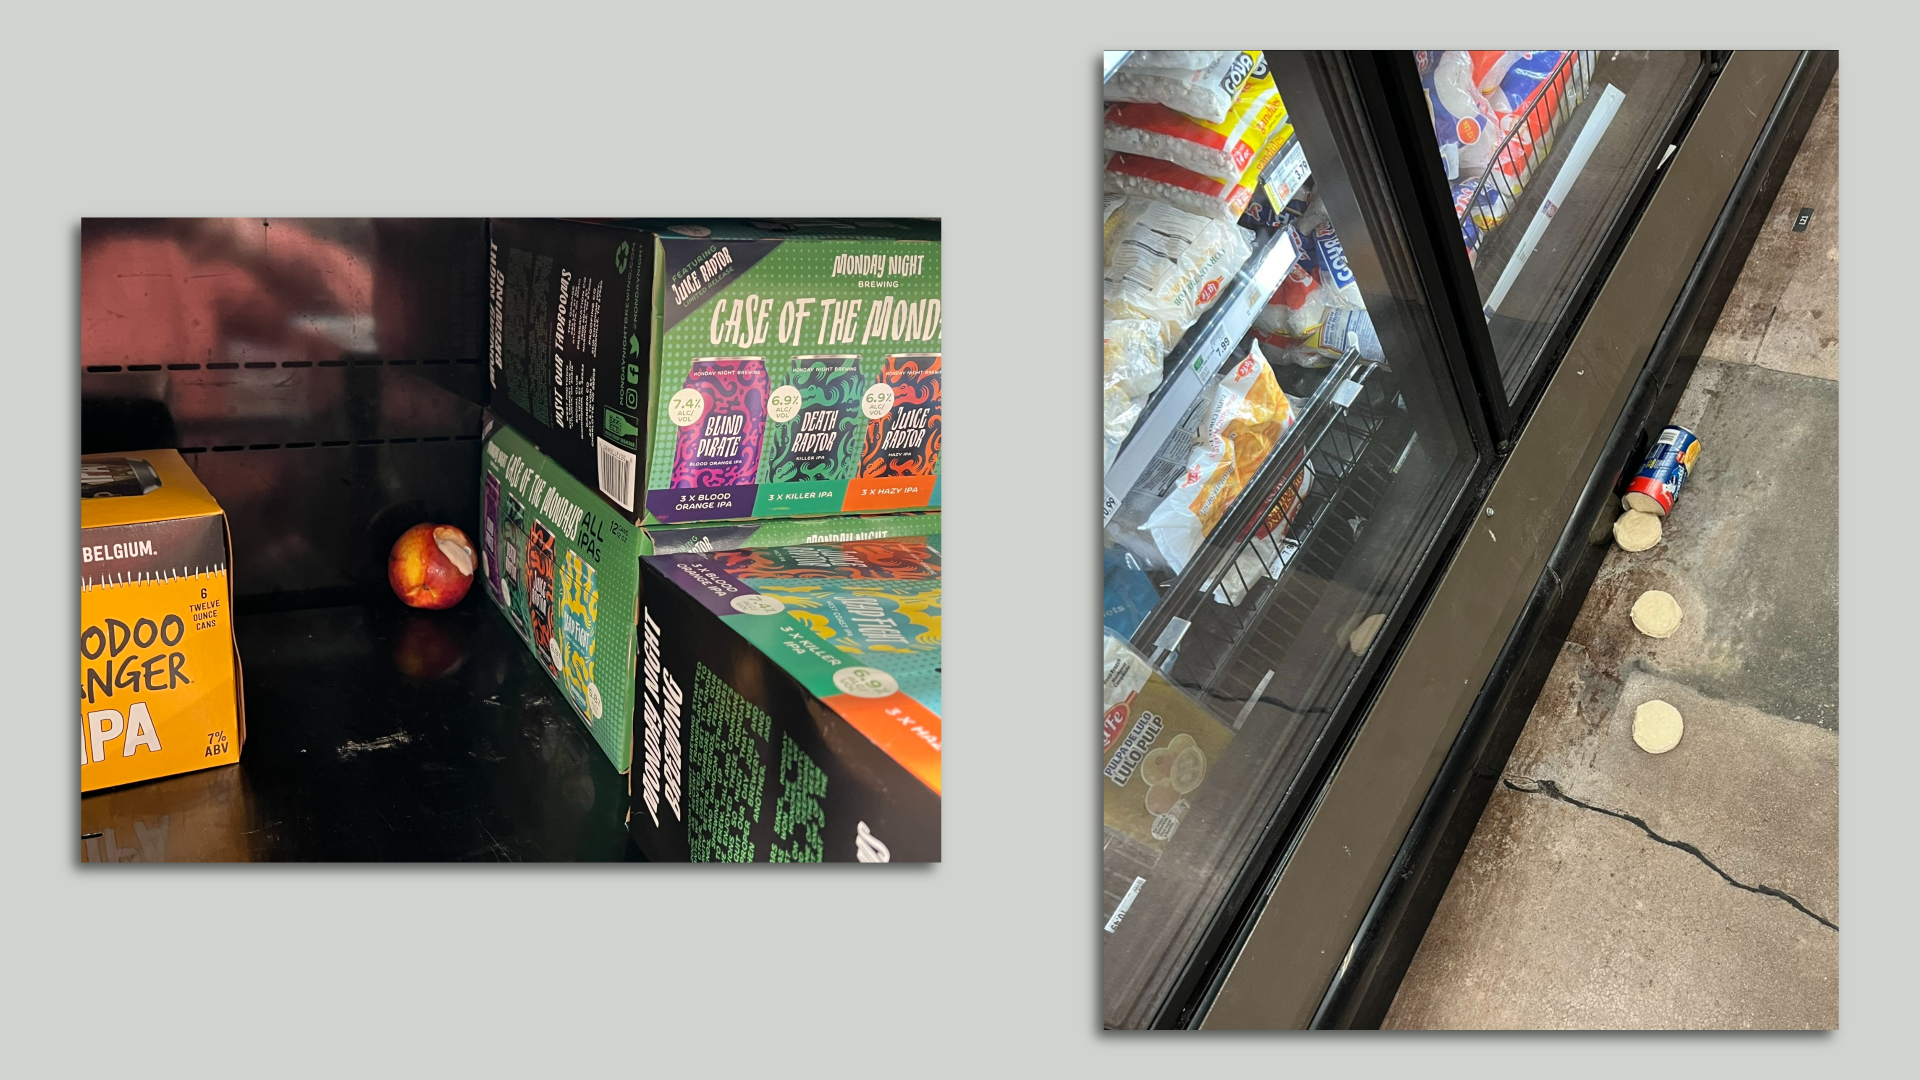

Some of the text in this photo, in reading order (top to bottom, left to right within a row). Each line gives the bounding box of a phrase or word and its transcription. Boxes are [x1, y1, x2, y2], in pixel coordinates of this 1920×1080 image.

[1224, 54, 1254, 95] GOYA
[671, 245, 717, 282] FEATURING
[671, 246, 733, 305] JUICE RAPTOR
[832, 253, 925, 278] MONDAY NIGHT
[683, 266, 735, 308] LIMITED RELEASE
[858, 280, 899, 288] BREWING
[495, 270, 504, 370] BREWING
[619, 242, 636, 406] MONDAYNIGHTBREWING.COM
[710, 294, 942, 349] CASE OF THE MOND
[554, 268, 572, 428] VISIT OUR TAPROOMS
[1215, 337, 1230, 357] 7.99
[673, 398, 702, 410] 7.4%
[772, 396, 800, 406] 6.9%
[866, 392, 892, 403] 6.9%
[704, 414, 744, 437] BLIND
[800, 409, 840, 432] DEATH
[891, 406, 931, 431] JUICE
[696, 436, 742, 458] PIRATE
[791, 431, 837, 453] RAPTOR
[881, 429, 927, 451] RAPTOR
[505, 453, 525, 488] CASE
[519, 467, 534, 498] OF
[528, 473, 547, 508] THE
[539, 486, 584, 541] MONDAYS
[698, 492, 731, 501] BLOOD
[785, 492, 816, 500] KILLER
[878, 487, 902, 495] HAZY
[675, 502, 715, 511] ORANGE
[581, 511, 604, 543] ALL
[610, 520, 618, 536] 12
[82, 540, 158, 563] BELGIUM.
[577, 529, 601, 563] IPAS
[676, 563, 727, 597] ORANGE IPA
[705, 572, 738, 593] BLOOD
[189, 599, 220, 613] TWELVE
[200, 588, 208, 599] 6
[193, 610, 218, 622] OUNCE
[196, 620, 216, 630] CANS
[833, 611, 849, 629] COAST
[851, 617, 910, 644] FIGHT
[783, 640, 806, 656] IPA
[798, 639, 843, 667] KILLER
[692, 661, 702, 712] STARTED
[701, 707, 707, 722] TO
[704, 668, 712, 703] KNOW
[853, 669, 891, 695] 6.9%
[712, 678, 722, 726] FRIENDS
[642, 605, 663, 829] MONDAY NIGHT
[693, 688, 704, 763] TRANSPLANTS
[727, 692, 739, 750] COMMUNE
[884, 706, 916, 726] 3 X
[1105, 711, 1124, 731] Fe
[204, 741, 229, 757] ABV
[207, 730, 227, 745] 7%
[662, 667, 683, 822] BREWING
[710, 682, 728, 804] RANDOM STRANGERS
[1104, 712, 1152, 776] PULPA DE LULO
[1114, 716, 1163, 785] LULO PULP
[700, 730, 710, 793] NEIGHBORS
[734, 728, 748, 802] MUCH THAT
[746, 737, 755, 770] JOBS
[718, 768, 722, 784] UP
[723, 696, 745, 846] ENJOYED THESE MONDAY
[747, 748, 761, 808] BREWERY
[752, 764, 767, 824] ANOTHER.
